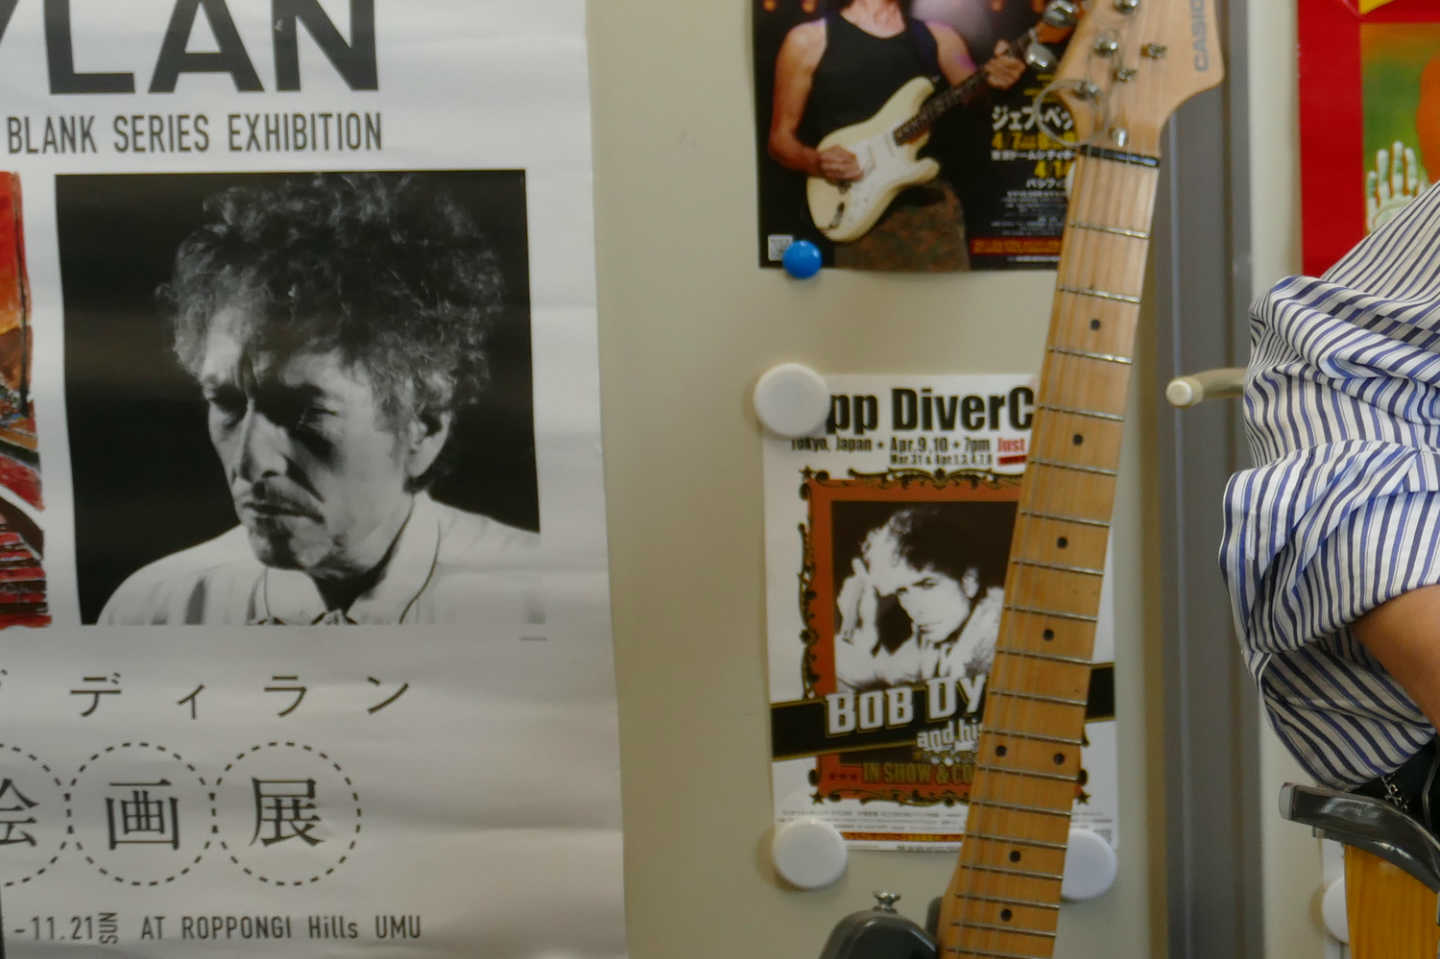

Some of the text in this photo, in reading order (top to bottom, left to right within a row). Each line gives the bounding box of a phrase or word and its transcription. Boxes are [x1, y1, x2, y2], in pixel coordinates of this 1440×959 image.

[7, 112, 383, 154] BLANK SERIES EXHIBITION
[826, 394, 879, 434] pp
[836, 436, 872, 453] Japan
[965, 437, 991, 453] 7pm
[826, 685, 914, 735] BOB
[917, 720, 955, 750] and
[863, 762, 880, 785] IN
[884, 762, 931, 785] SHOW
[98, 912, 119, 945] SUN
[141, 915, 166, 940] AT
[181, 914, 293, 940] ROPPONGI
[307, 914, 359, 940] Hills
[375, 914, 422, 940] UMU
